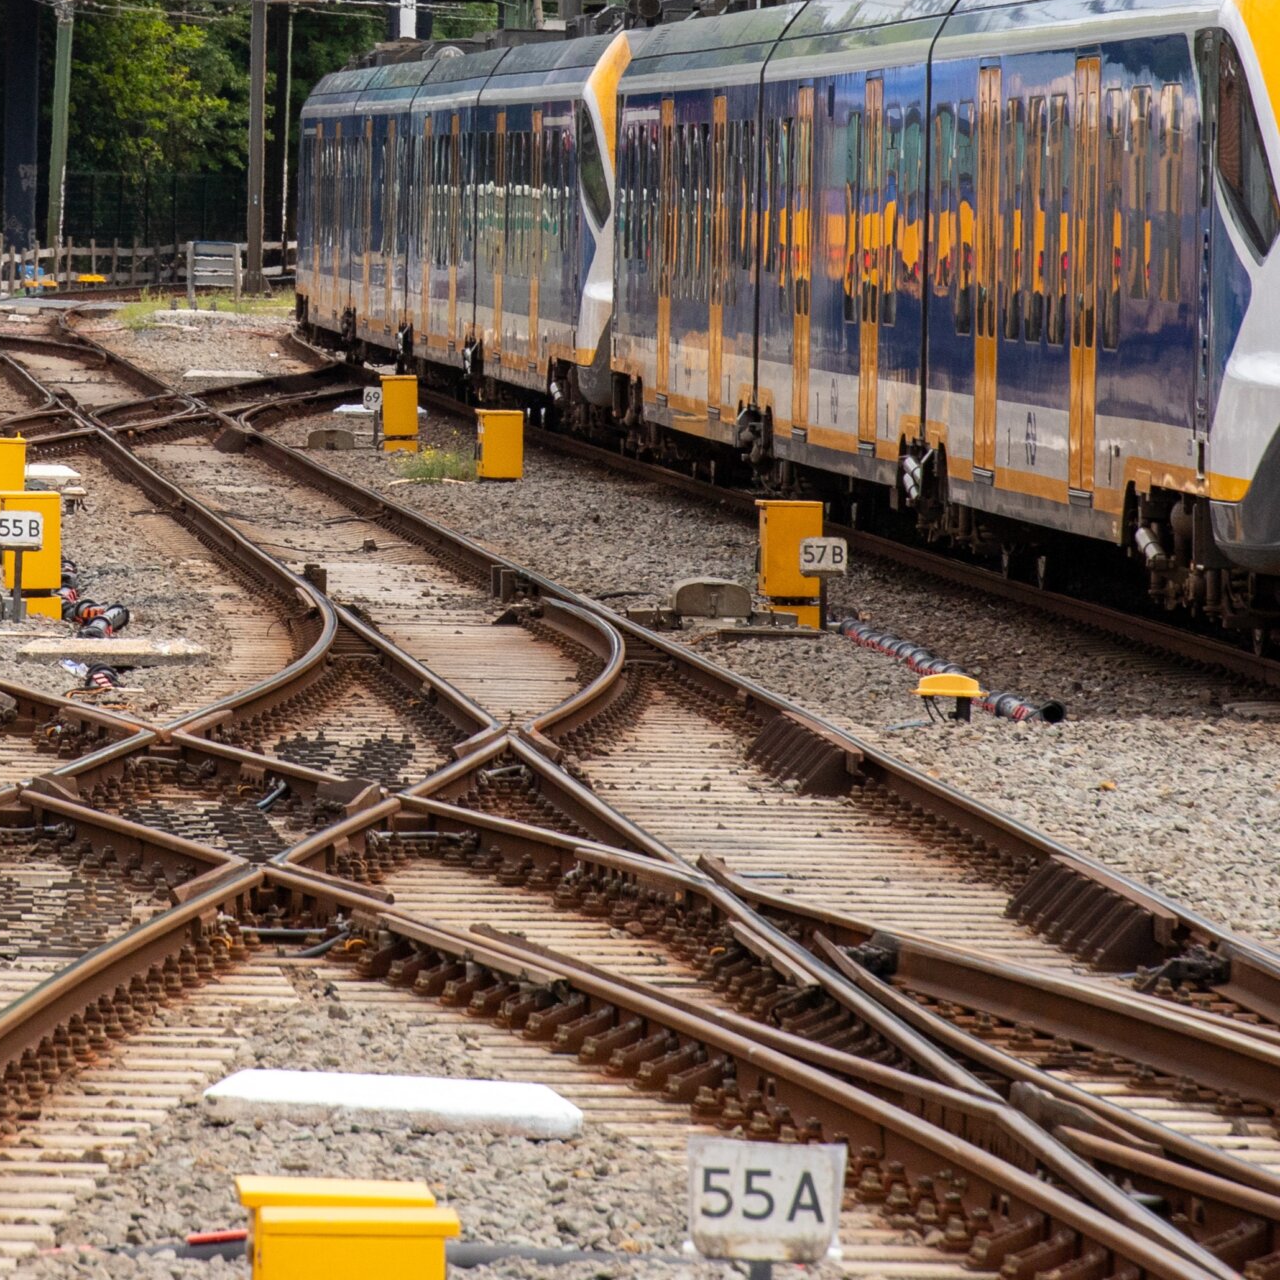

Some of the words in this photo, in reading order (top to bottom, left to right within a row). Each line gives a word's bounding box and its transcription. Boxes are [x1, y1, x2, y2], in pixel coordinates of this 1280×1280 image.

[365, 391, 381, 403] 69
[803, 545, 844, 564] 57B
[700, 1165, 825, 1225] 55A
